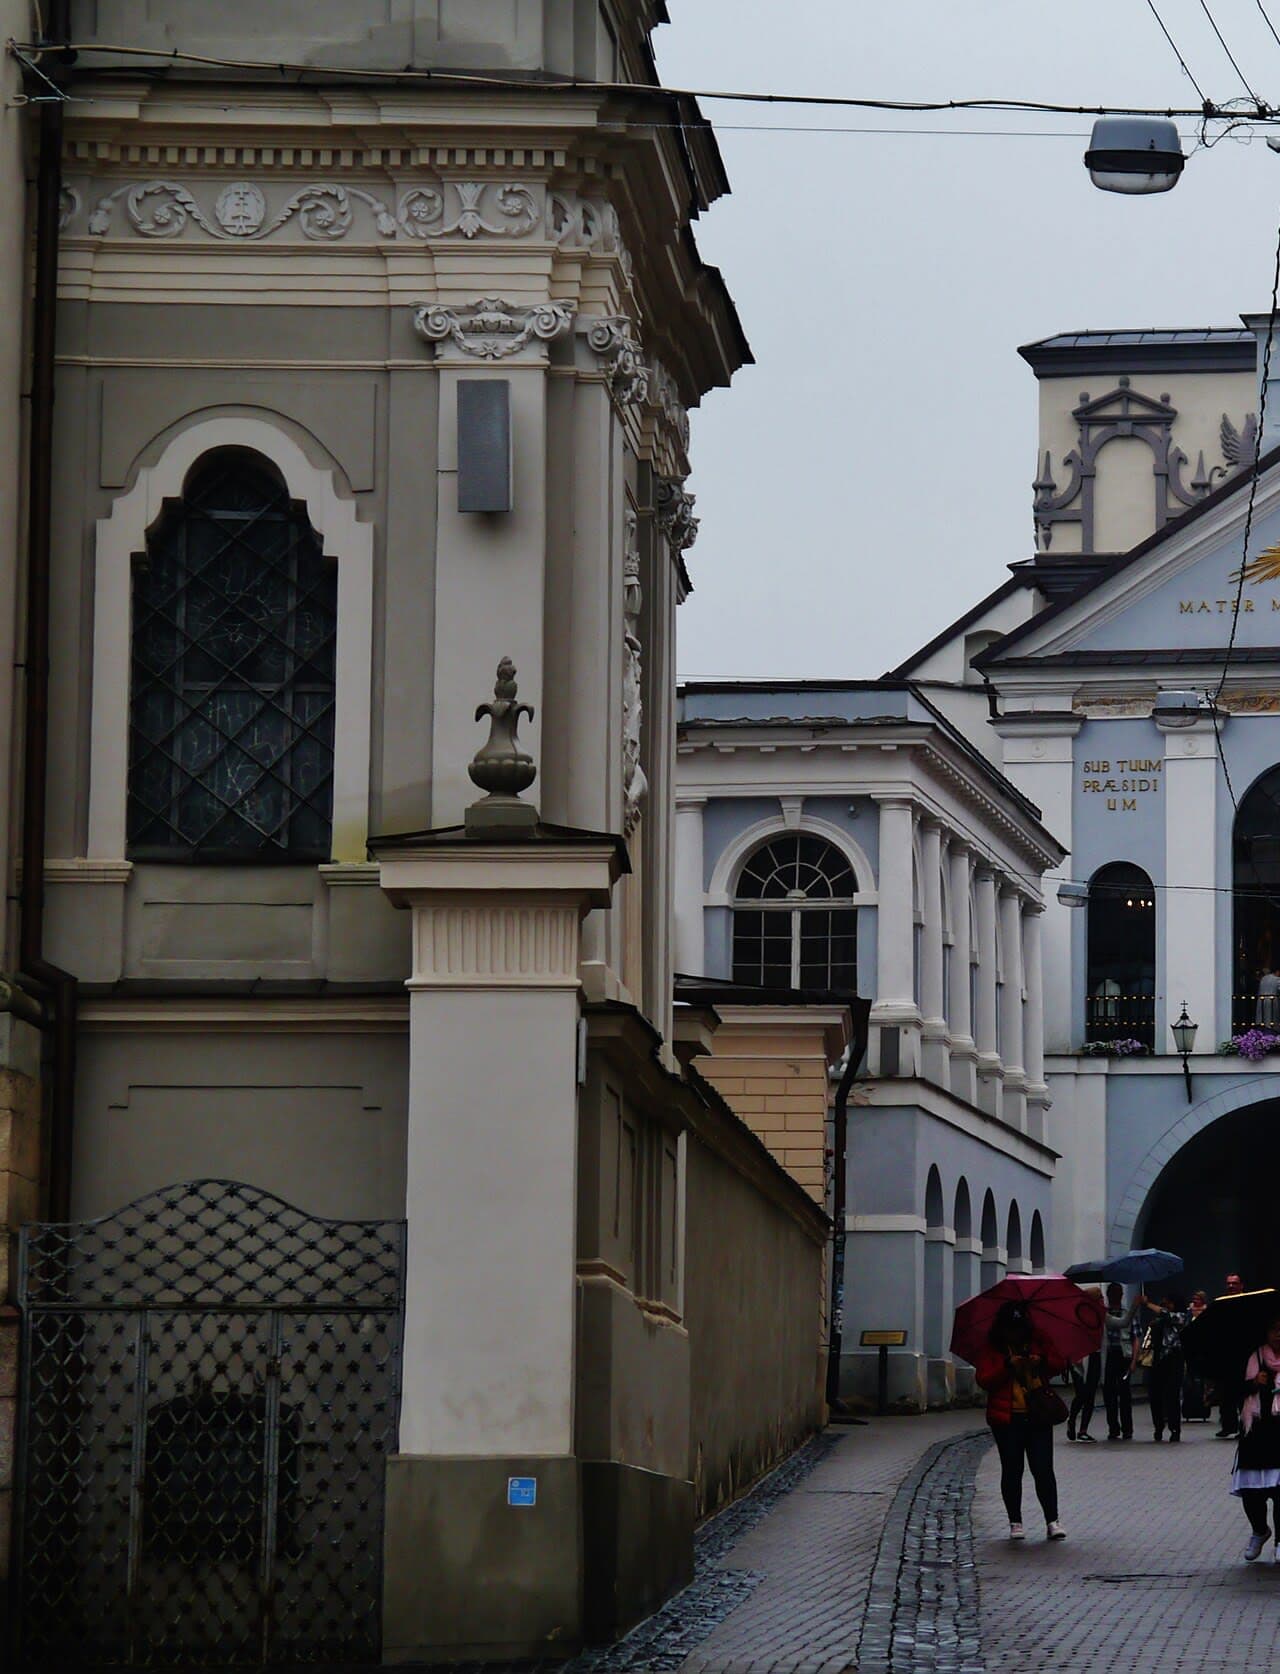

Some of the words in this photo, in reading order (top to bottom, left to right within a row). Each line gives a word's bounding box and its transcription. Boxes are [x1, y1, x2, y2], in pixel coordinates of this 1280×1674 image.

[1179, 599, 1255, 613] MATER
[1083, 760, 1110, 773] SUB
[1116, 759, 1162, 772] TUUM
[1082, 779, 1158, 793] PRÆSIDI
